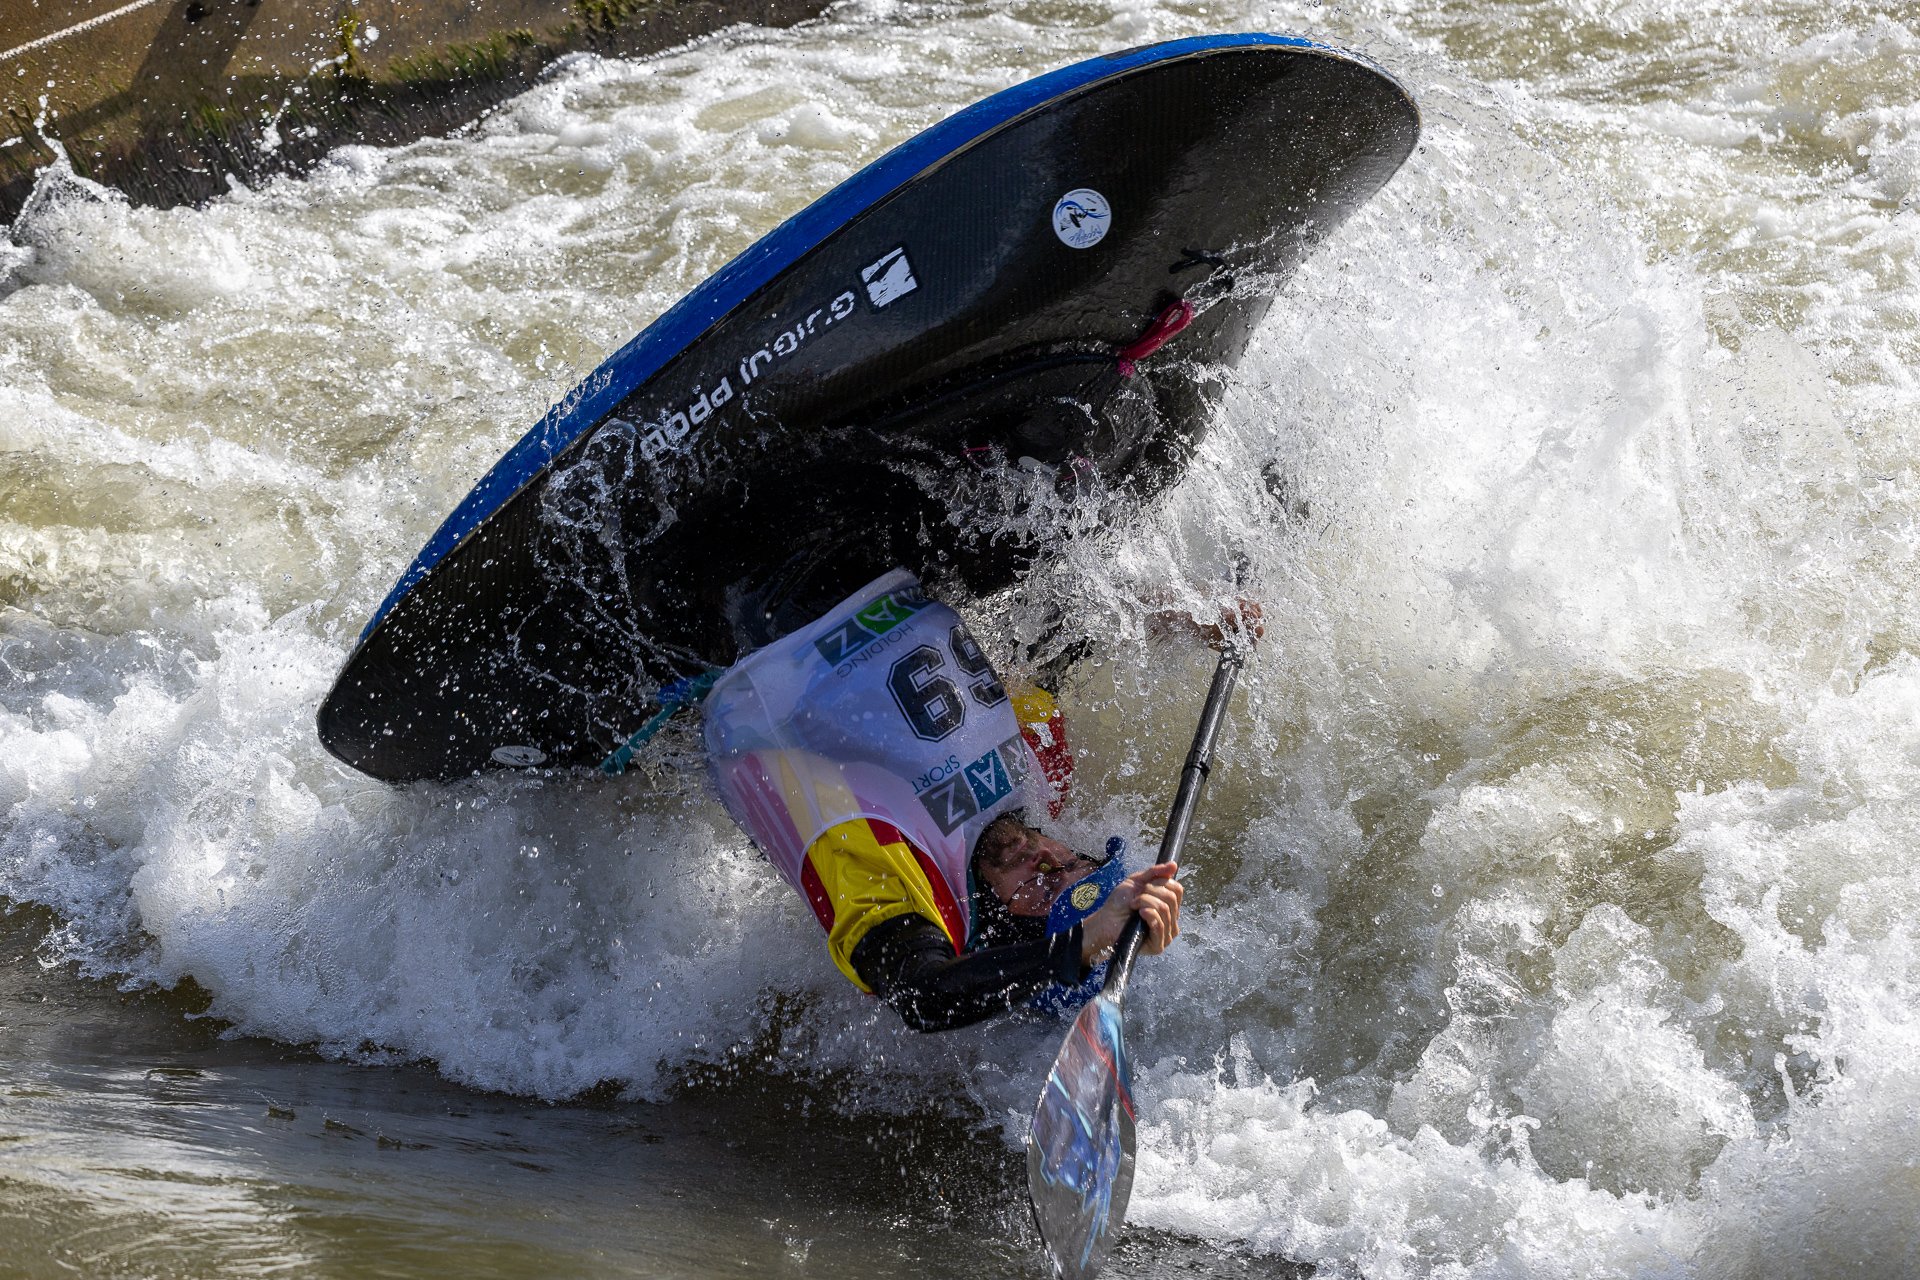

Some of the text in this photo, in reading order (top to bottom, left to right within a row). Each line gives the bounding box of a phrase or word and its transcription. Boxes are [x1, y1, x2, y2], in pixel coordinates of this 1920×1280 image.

[639, 376, 734, 461] PROD
[836, 622, 914, 679] HOLDING
[886, 624, 1008, 743] 69
[911, 754, 961, 796] SPORT
[930, 738, 1029, 827] RAZ
